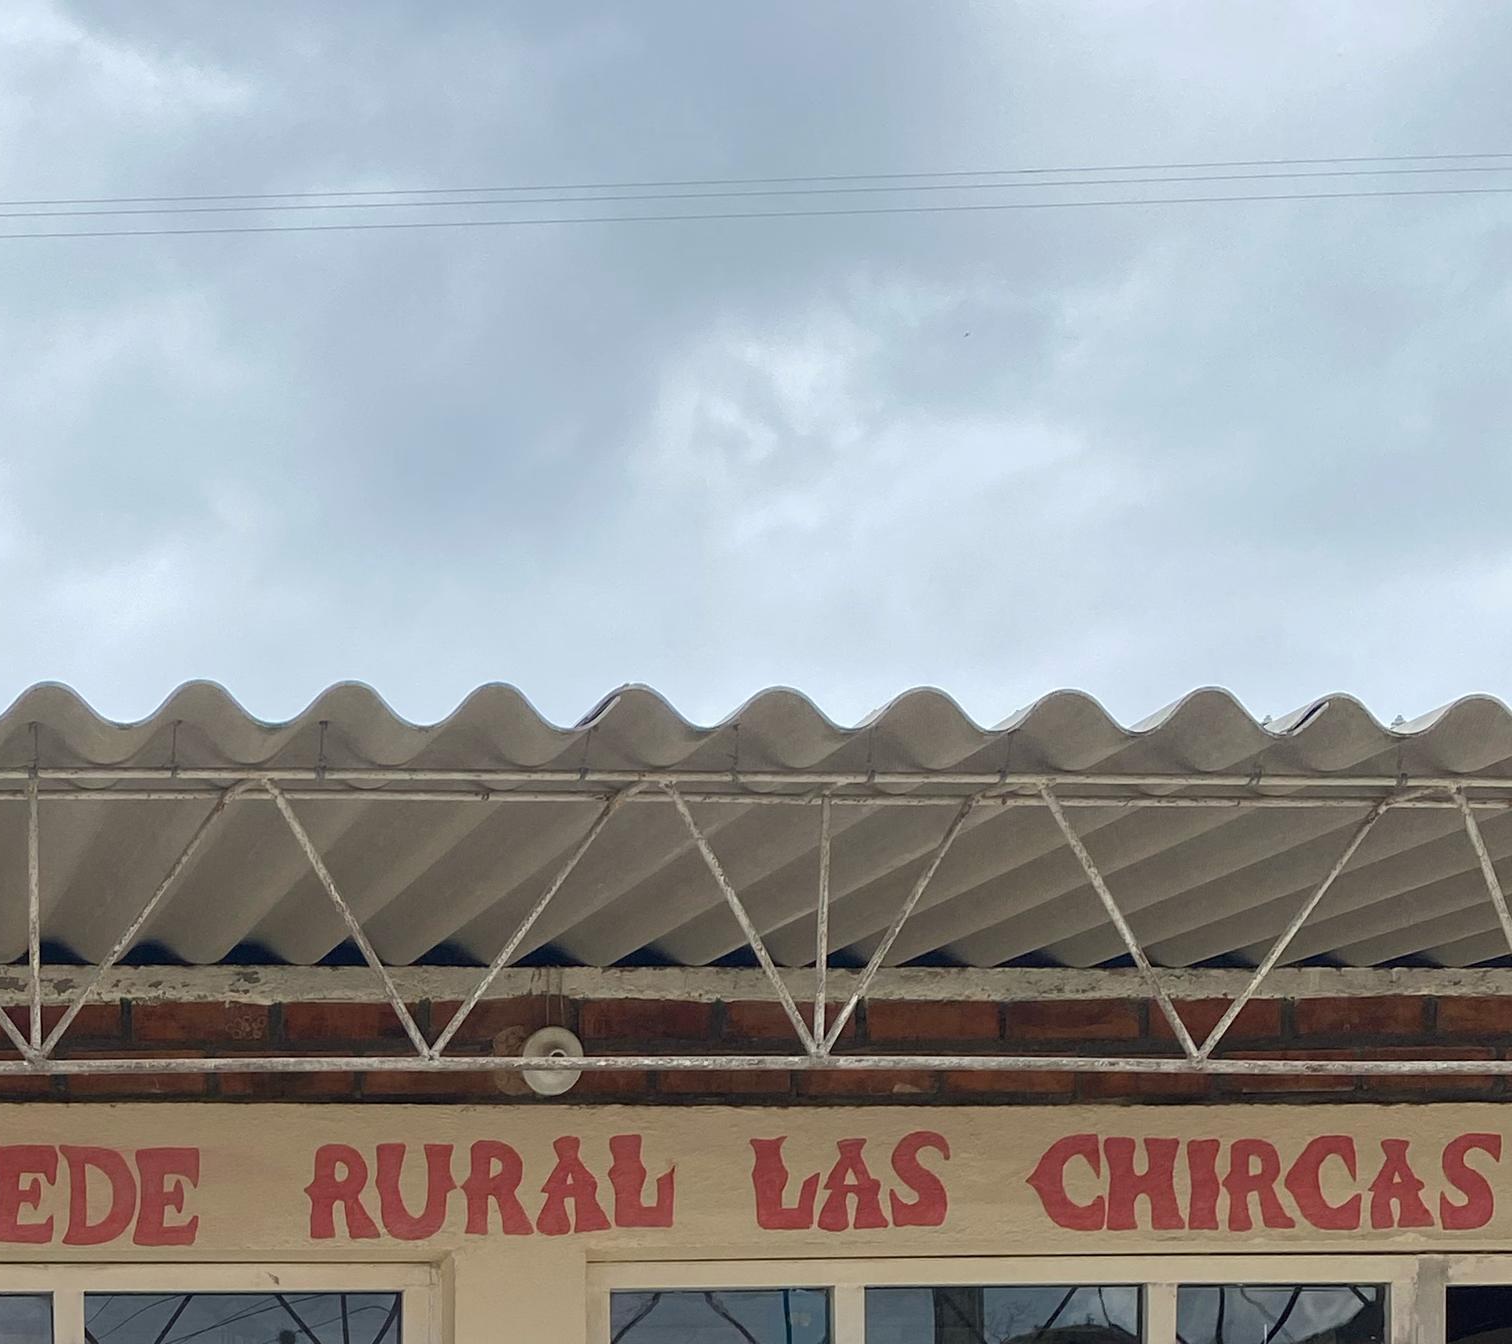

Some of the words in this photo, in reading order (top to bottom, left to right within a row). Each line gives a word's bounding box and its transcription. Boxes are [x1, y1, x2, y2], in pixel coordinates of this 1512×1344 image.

[303, 1133, 677, 1241] RURAL
[749, 1130, 952, 1233] LAS
[1025, 1132, 1502, 1232] CHIRCAS
